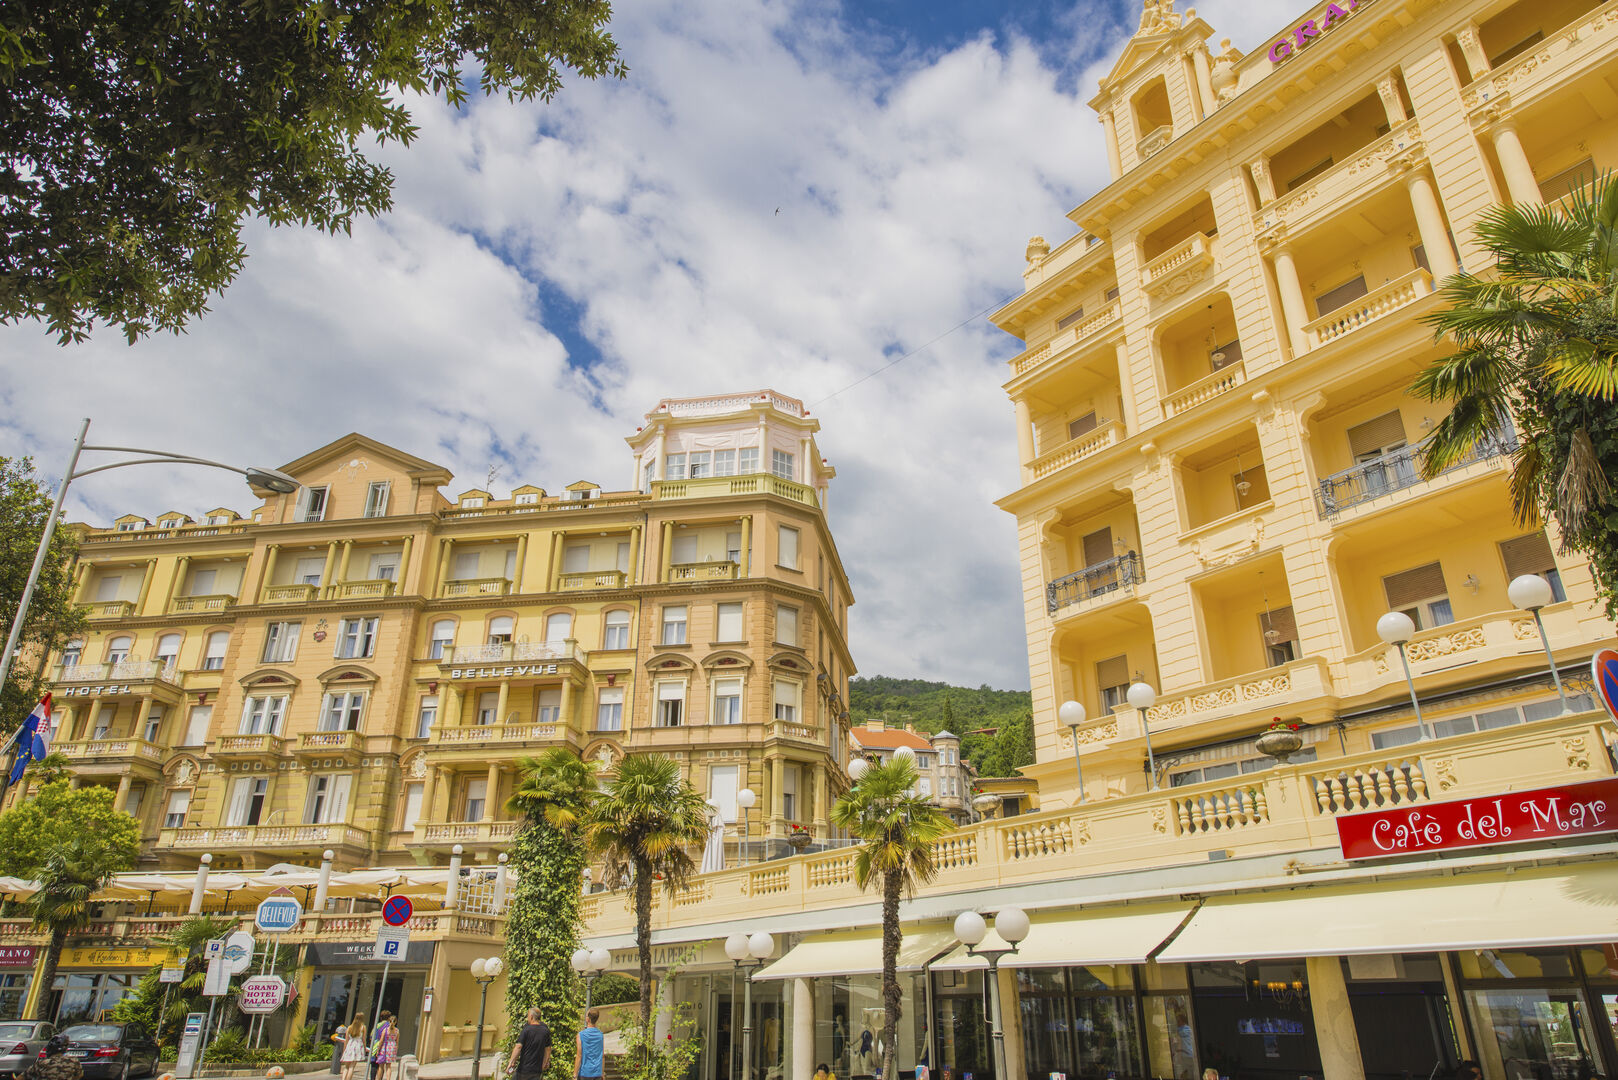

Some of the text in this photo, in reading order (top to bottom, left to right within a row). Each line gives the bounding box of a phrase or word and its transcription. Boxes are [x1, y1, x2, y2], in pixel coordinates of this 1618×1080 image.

[452, 664, 557, 679] BELLEVUE
[65, 685, 131, 697] HOTEL
[1372, 797, 1607, 851] Cafè del Mar
[260, 905, 297, 924] BELLEVUE
[654, 948, 666, 965] LA
